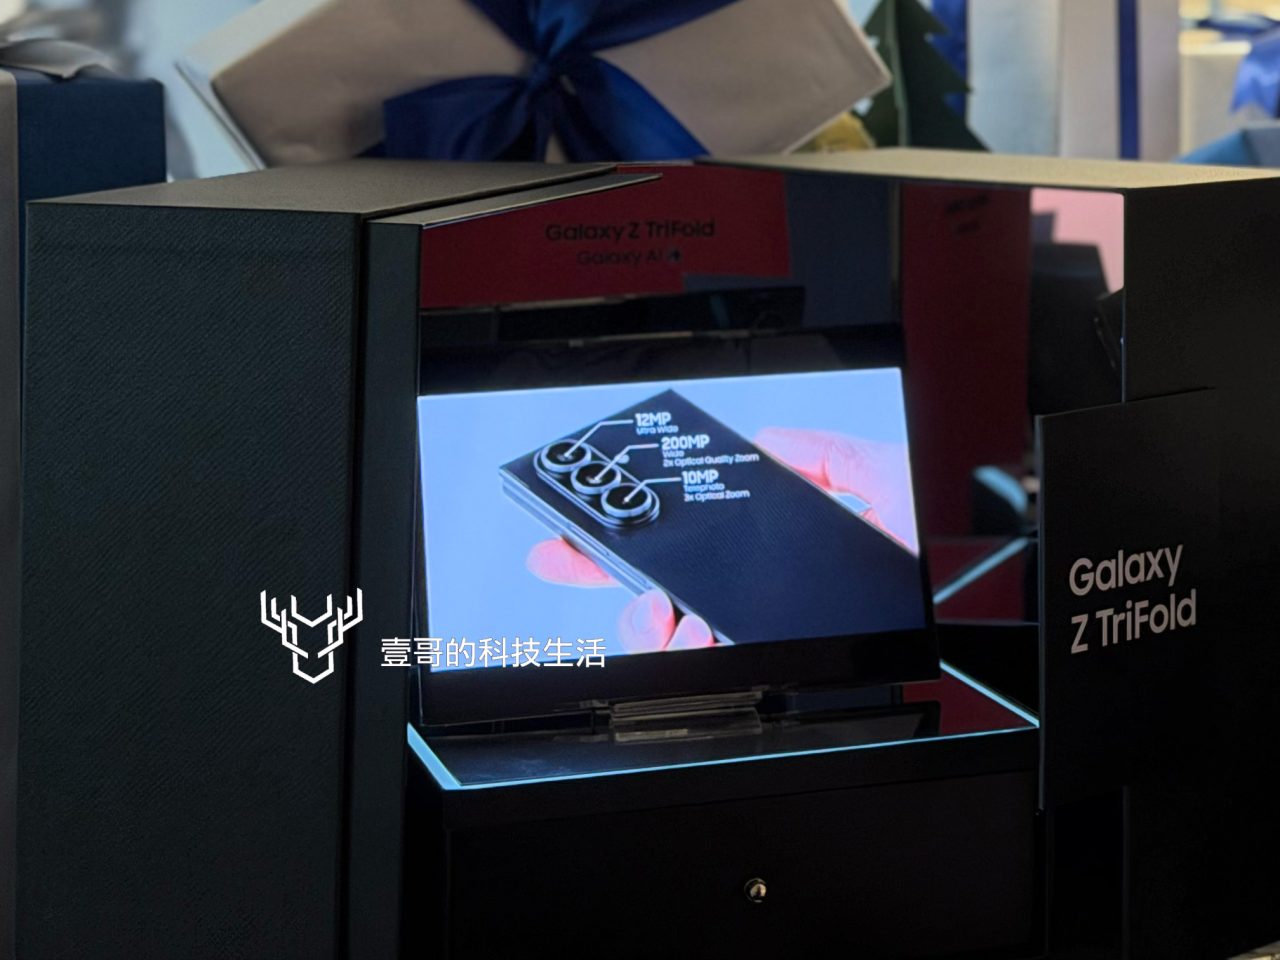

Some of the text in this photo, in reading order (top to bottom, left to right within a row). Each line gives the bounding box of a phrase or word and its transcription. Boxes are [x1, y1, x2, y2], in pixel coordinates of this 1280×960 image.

[544, 217, 716, 245] Galaxy Z TriFold
[576, 249, 640, 266] Galaxy
[635, 412, 671, 427] 12MP
[657, 425, 679, 434] Wide
[661, 434, 710, 450] 200MP
[662, 450, 685, 458] Wide
[674, 457, 704, 467] Optical
[704, 455, 734, 465] Quality
[735, 453, 760, 463] Zoom
[682, 469, 719, 484] 10MP
[695, 491, 724, 501] Optical
[725, 489, 750, 499] Zoom
[1069, 544, 1183, 596] Galaxy
[1071, 588, 1197, 654] Z TriFold
